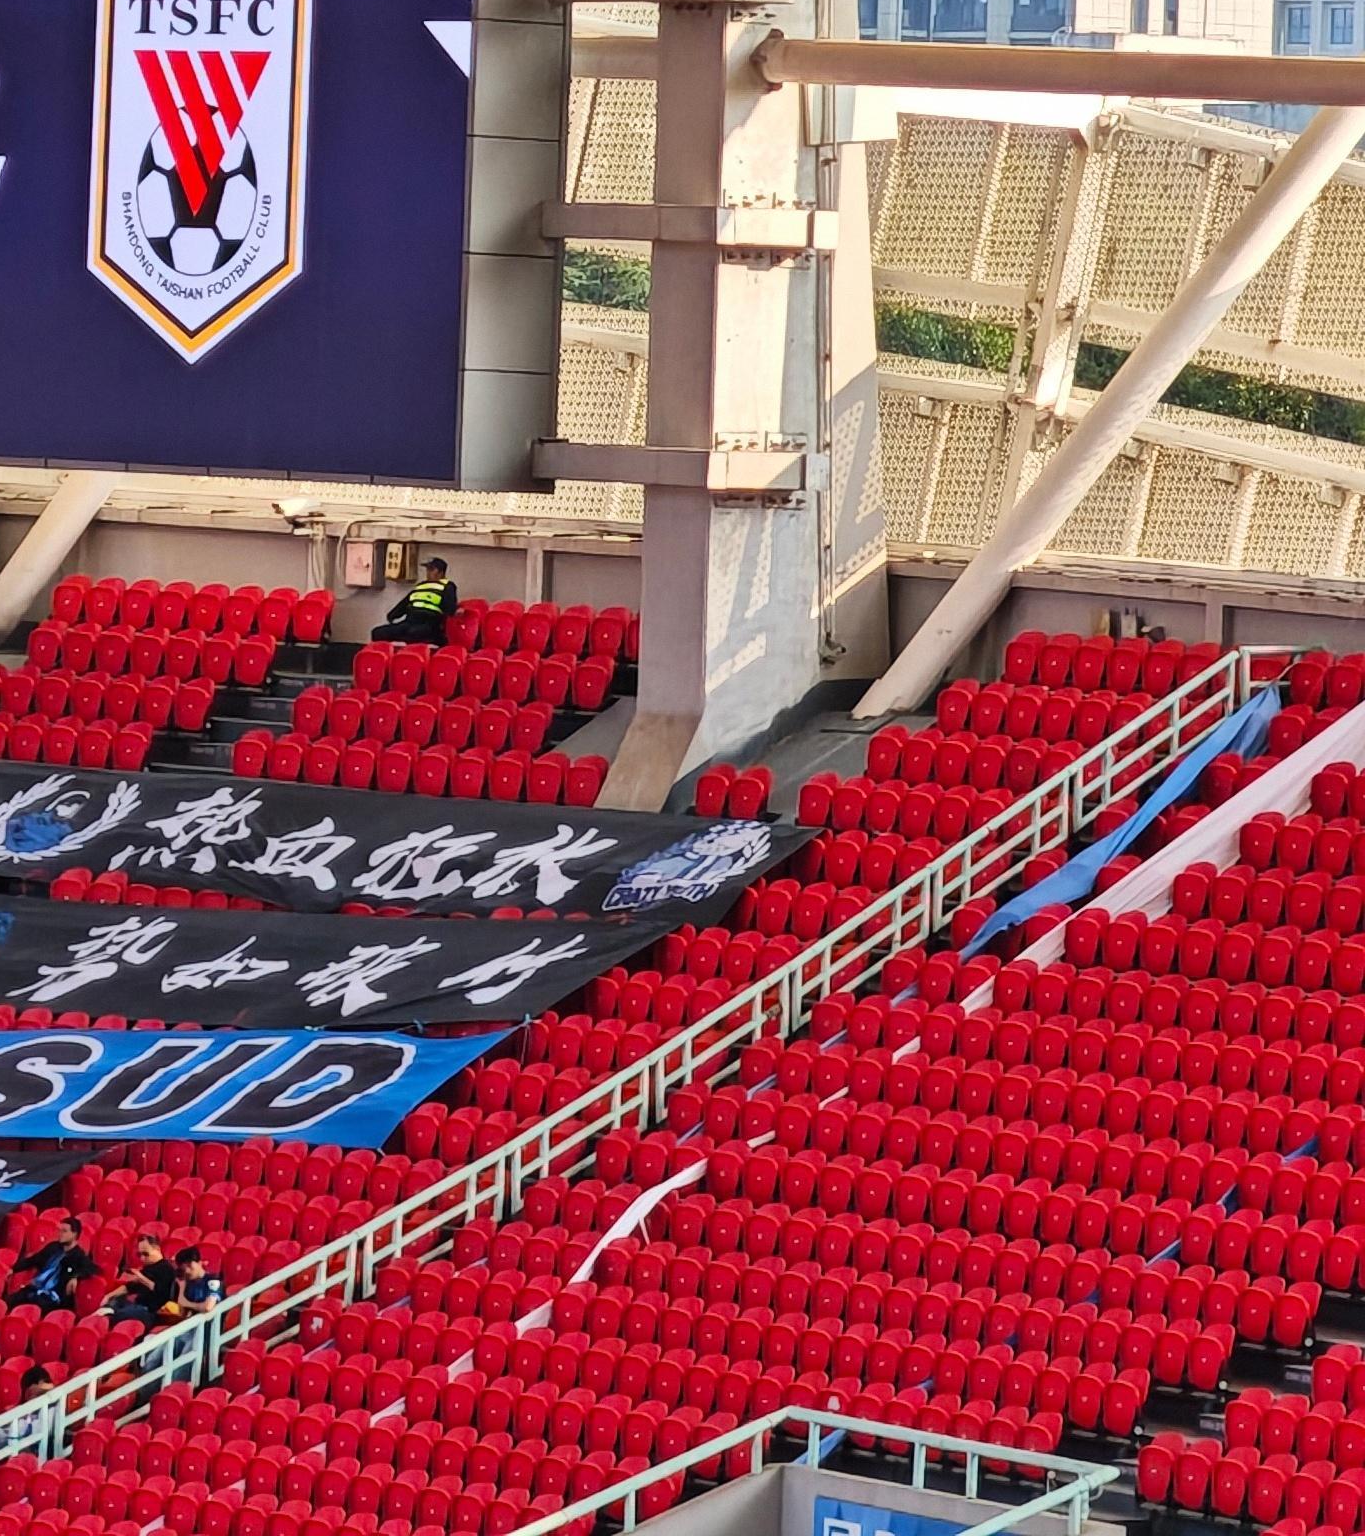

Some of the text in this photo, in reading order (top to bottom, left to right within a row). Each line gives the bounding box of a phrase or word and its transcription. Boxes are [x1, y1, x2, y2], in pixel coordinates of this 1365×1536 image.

[121, 191, 272, 300] SHANDONG TAISHAN FOOTBALL CLUB
